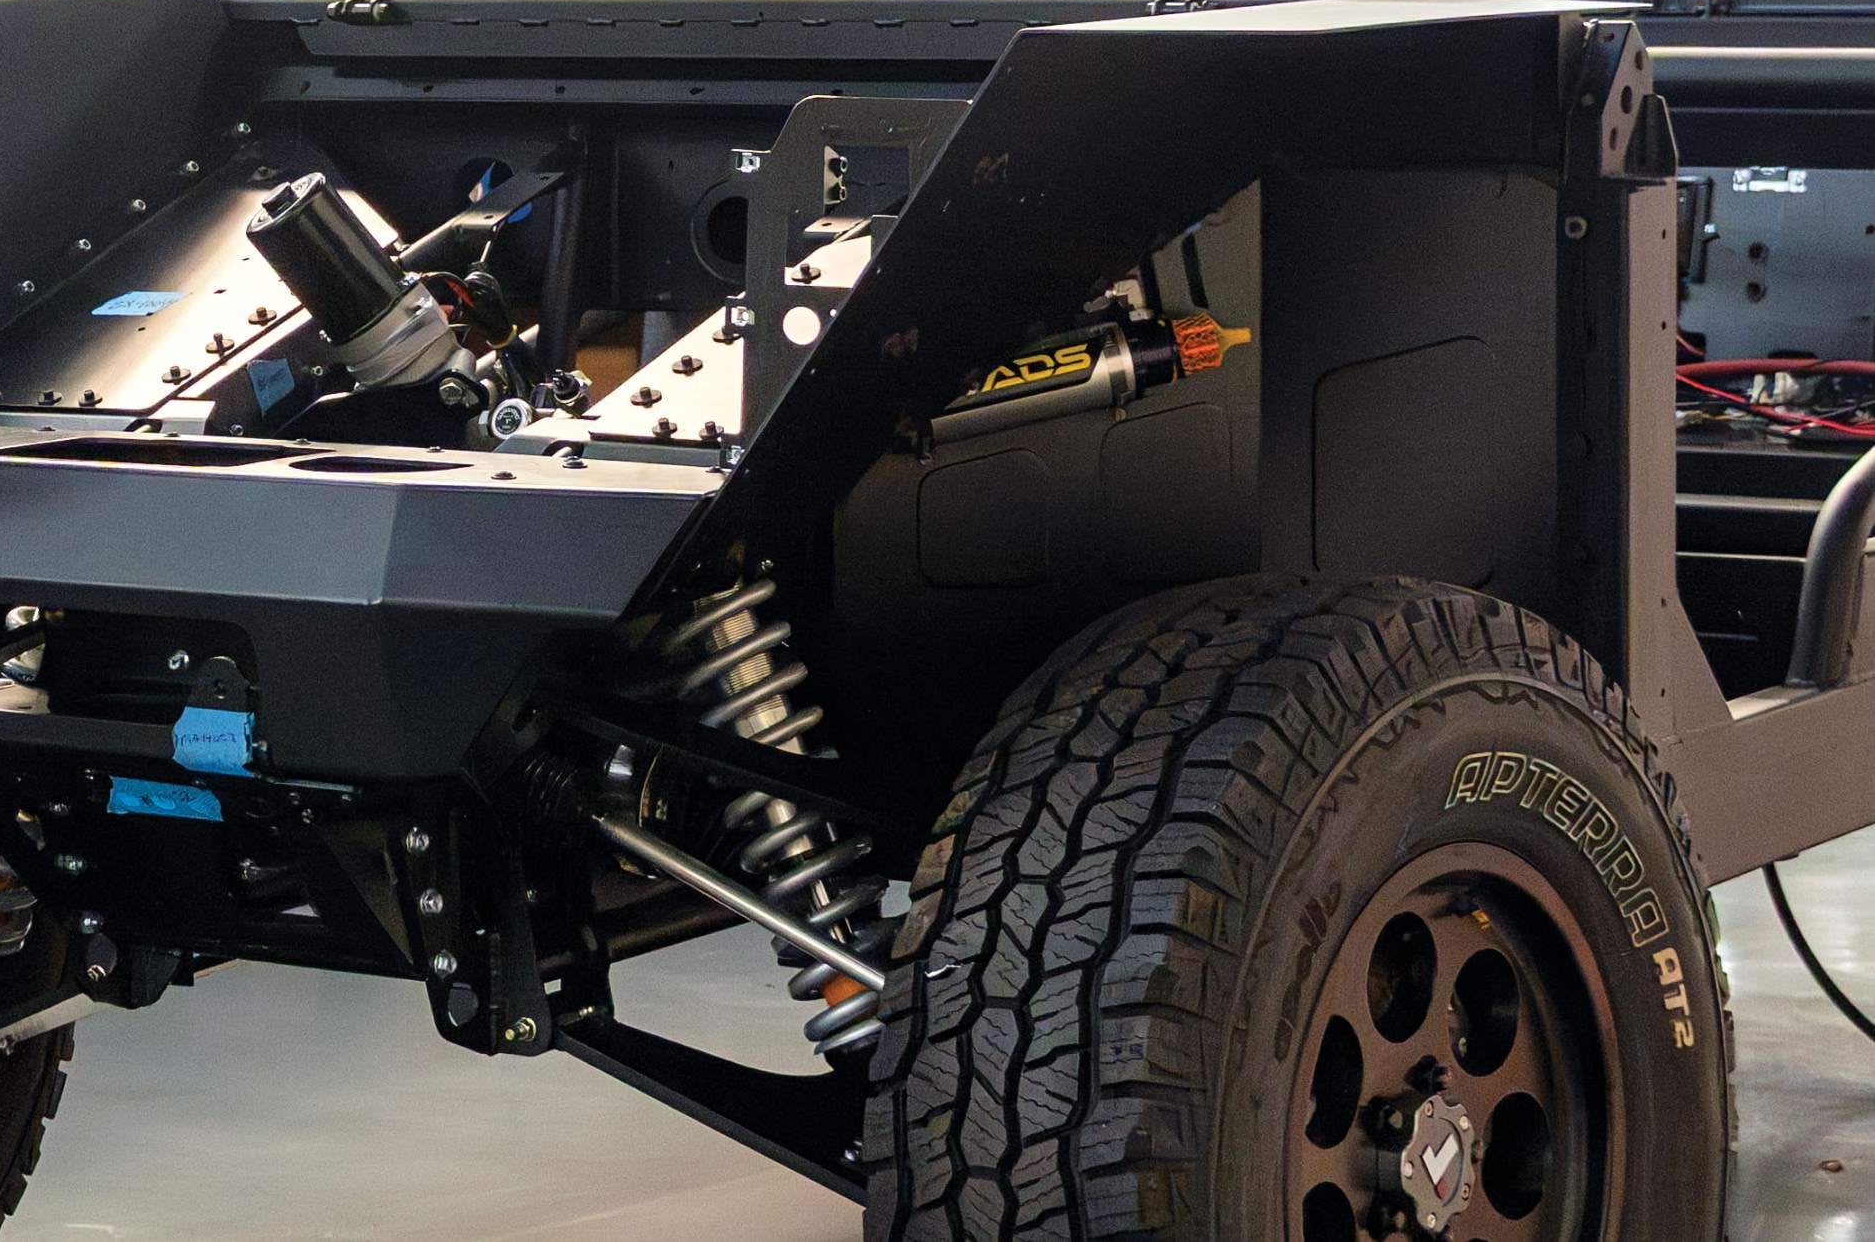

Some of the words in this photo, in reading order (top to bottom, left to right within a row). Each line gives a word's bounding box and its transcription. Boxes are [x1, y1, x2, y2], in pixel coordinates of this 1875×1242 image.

[981, 343, 1092, 393] ADS
[1444, 751, 1670, 948] APTERRA
[1652, 947, 1695, 1049] AT2
